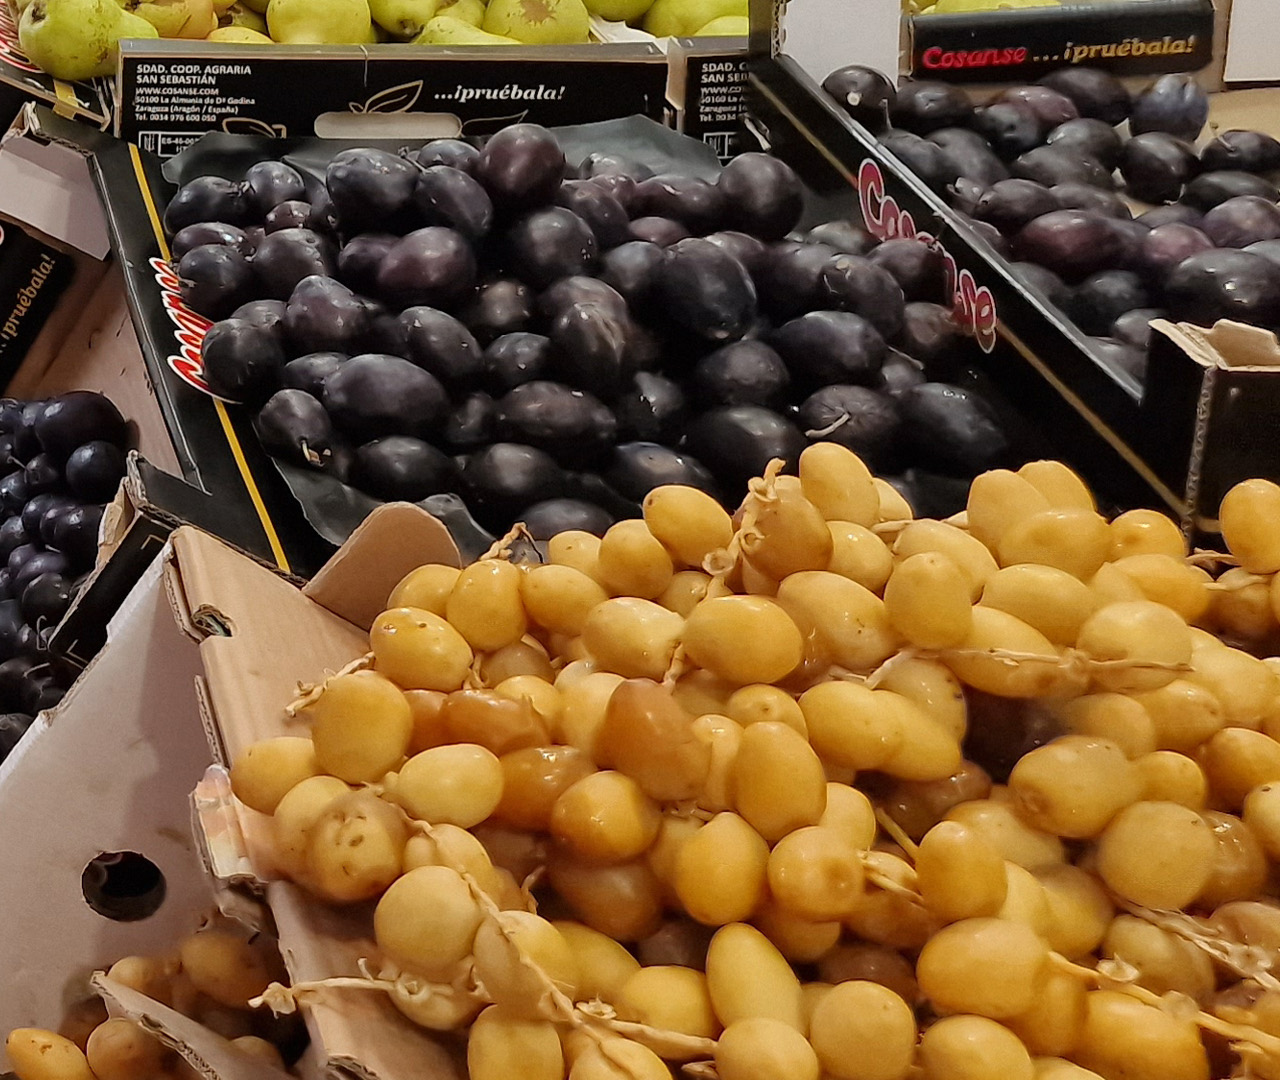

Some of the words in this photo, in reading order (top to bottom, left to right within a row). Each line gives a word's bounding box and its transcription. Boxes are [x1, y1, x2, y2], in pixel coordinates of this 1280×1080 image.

[922, 46, 1028, 69] Cosanse
[136, 64, 168, 74] SDAD.
[170, 65, 202, 74] COOP.
[204, 65, 251, 75] AGRARIA
[136, 75, 157, 84] SAN
[160, 74, 216, 85] SEBASTIÁN
[701, 73, 724, 83] SAN
